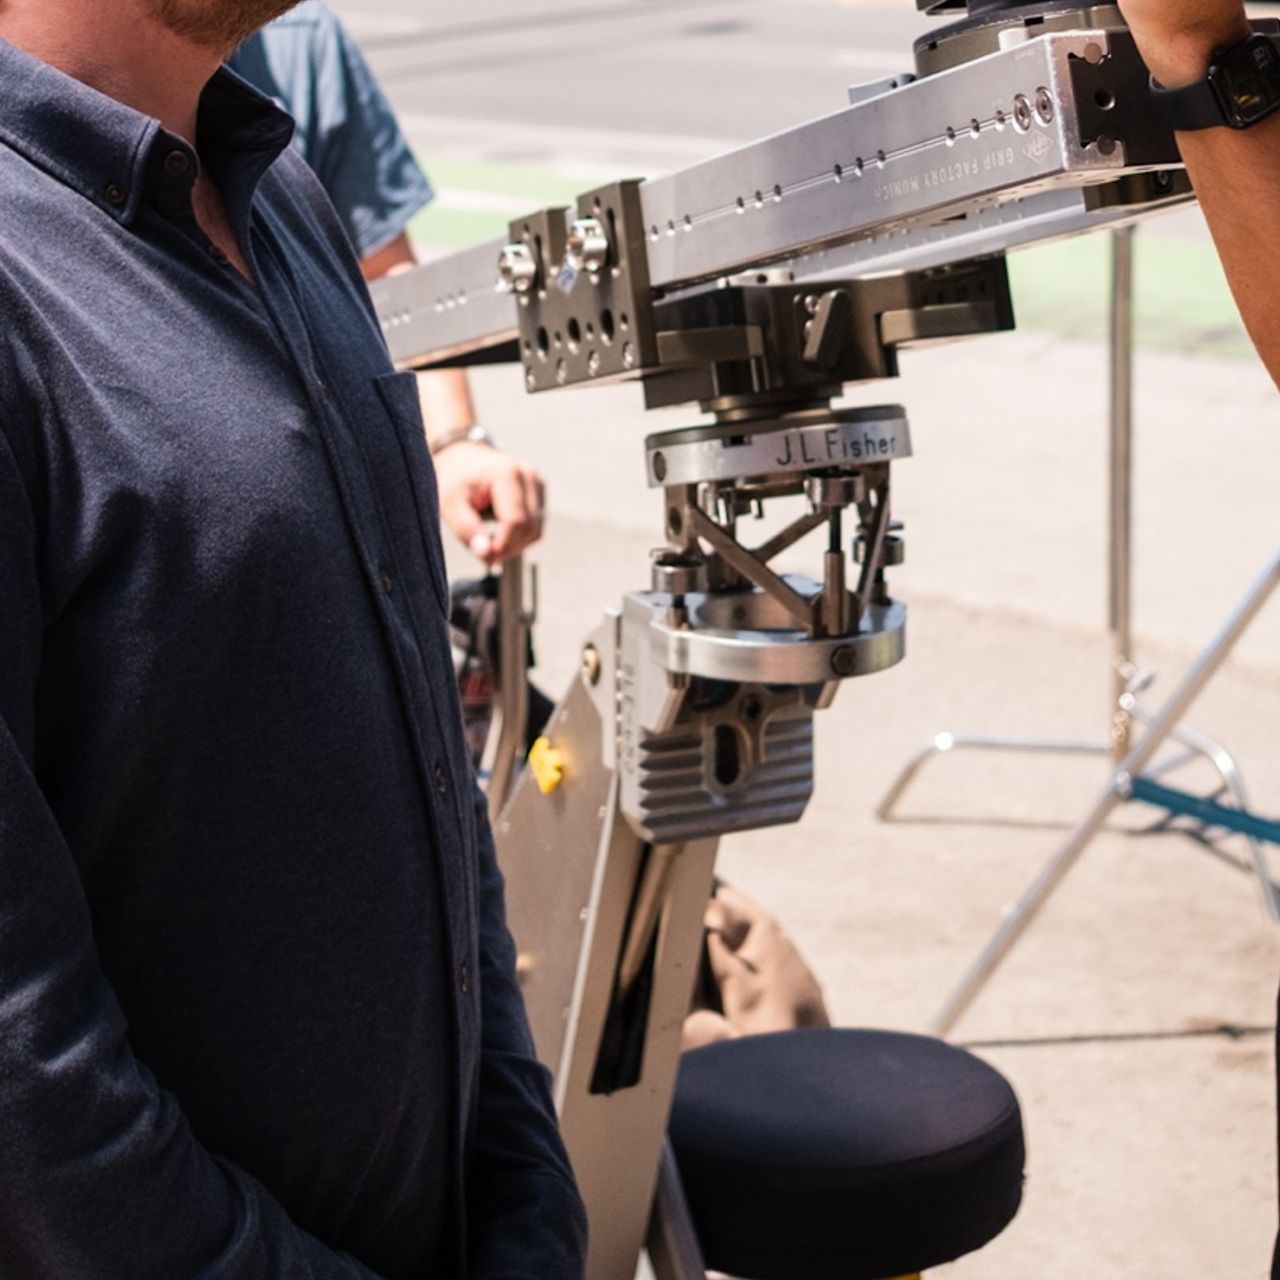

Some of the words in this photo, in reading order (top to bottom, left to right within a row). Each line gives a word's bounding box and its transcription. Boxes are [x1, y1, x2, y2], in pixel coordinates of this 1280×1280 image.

[984, 147, 1014, 169] GRIP
[925, 159, 979, 189] FACTORY
[873, 176, 919, 201] MUNICH
